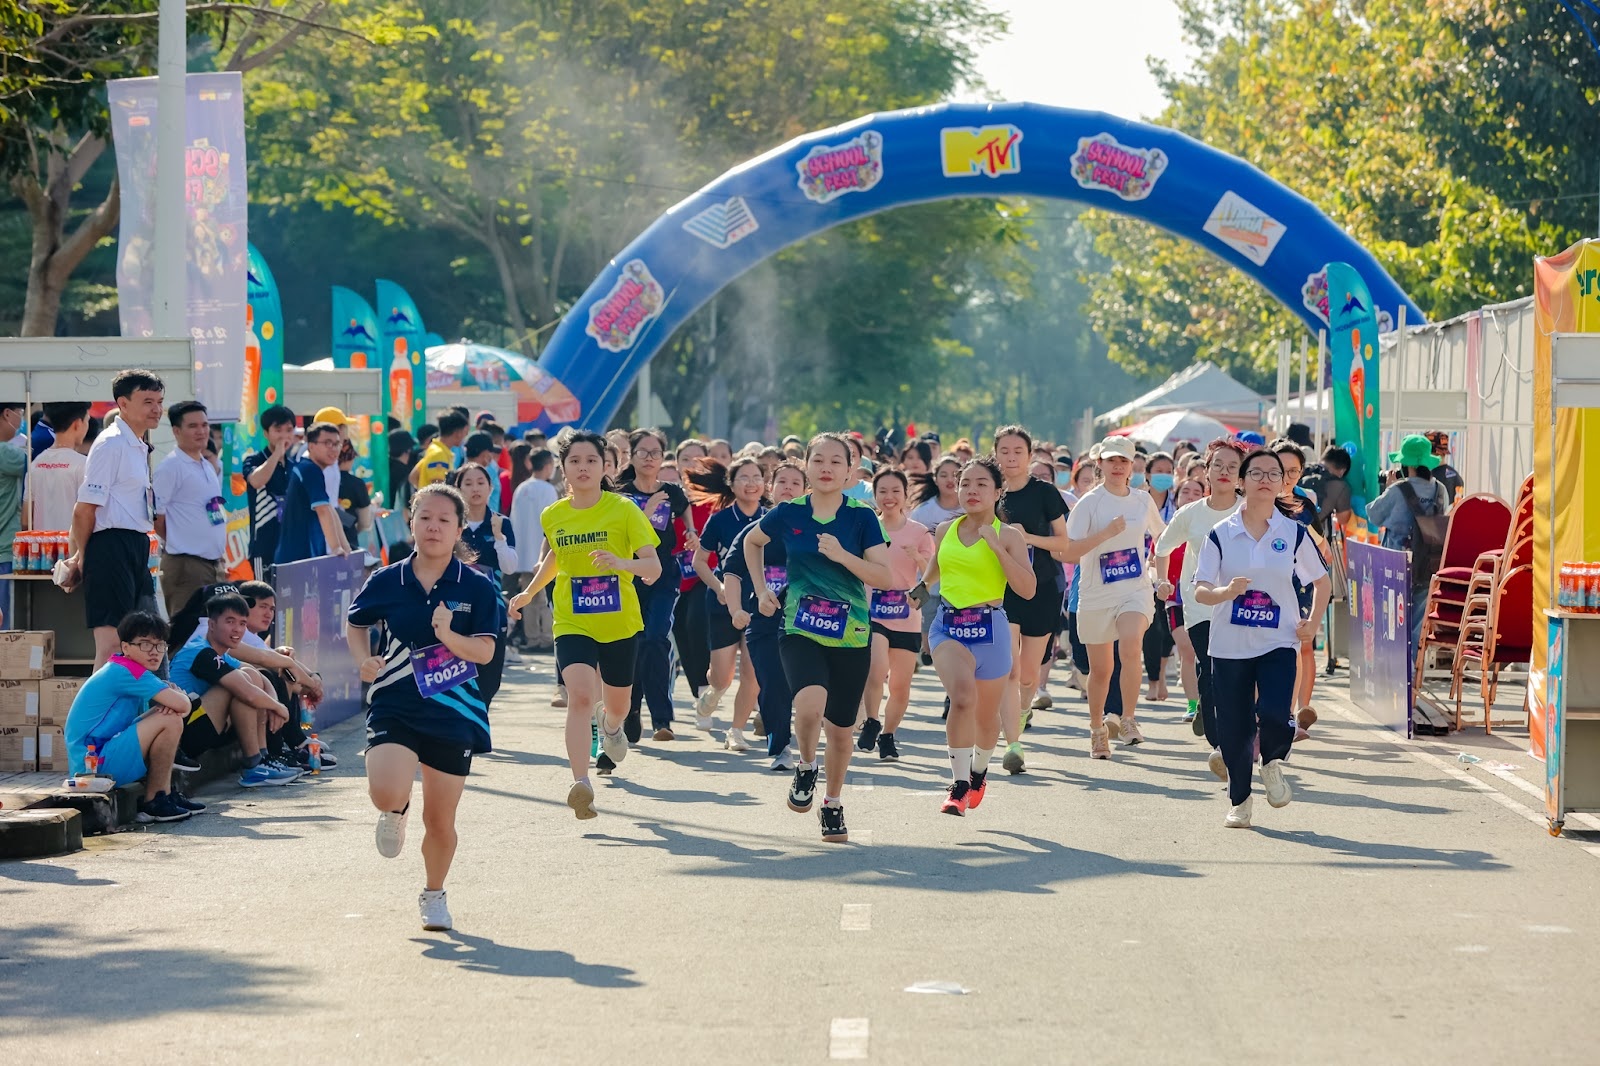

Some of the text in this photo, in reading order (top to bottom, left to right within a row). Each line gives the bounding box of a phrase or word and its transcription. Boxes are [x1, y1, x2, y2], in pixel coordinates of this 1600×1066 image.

[808, 145, 870, 177] SCHOOL
[943, 130, 1019, 175] MTV
[1087, 140, 1147, 179] SCHOOL
[824, 169, 858, 192] FEST
[1091, 165, 1128, 191] FEST
[593, 278, 645, 332] SCHOOL
[616, 301, 649, 335] FEST
[649, 513, 664, 524] 66
[555, 532, 596, 548] VIETNAM
[1105, 563, 1137, 578] F0816
[577, 594, 614, 607] F0011
[875, 604, 905, 615] F0907
[801, 611, 840, 632] F1096
[1237, 607, 1274, 621] F0750
[948, 627, 987, 638] F0859
[424, 660, 468, 687] F0023
